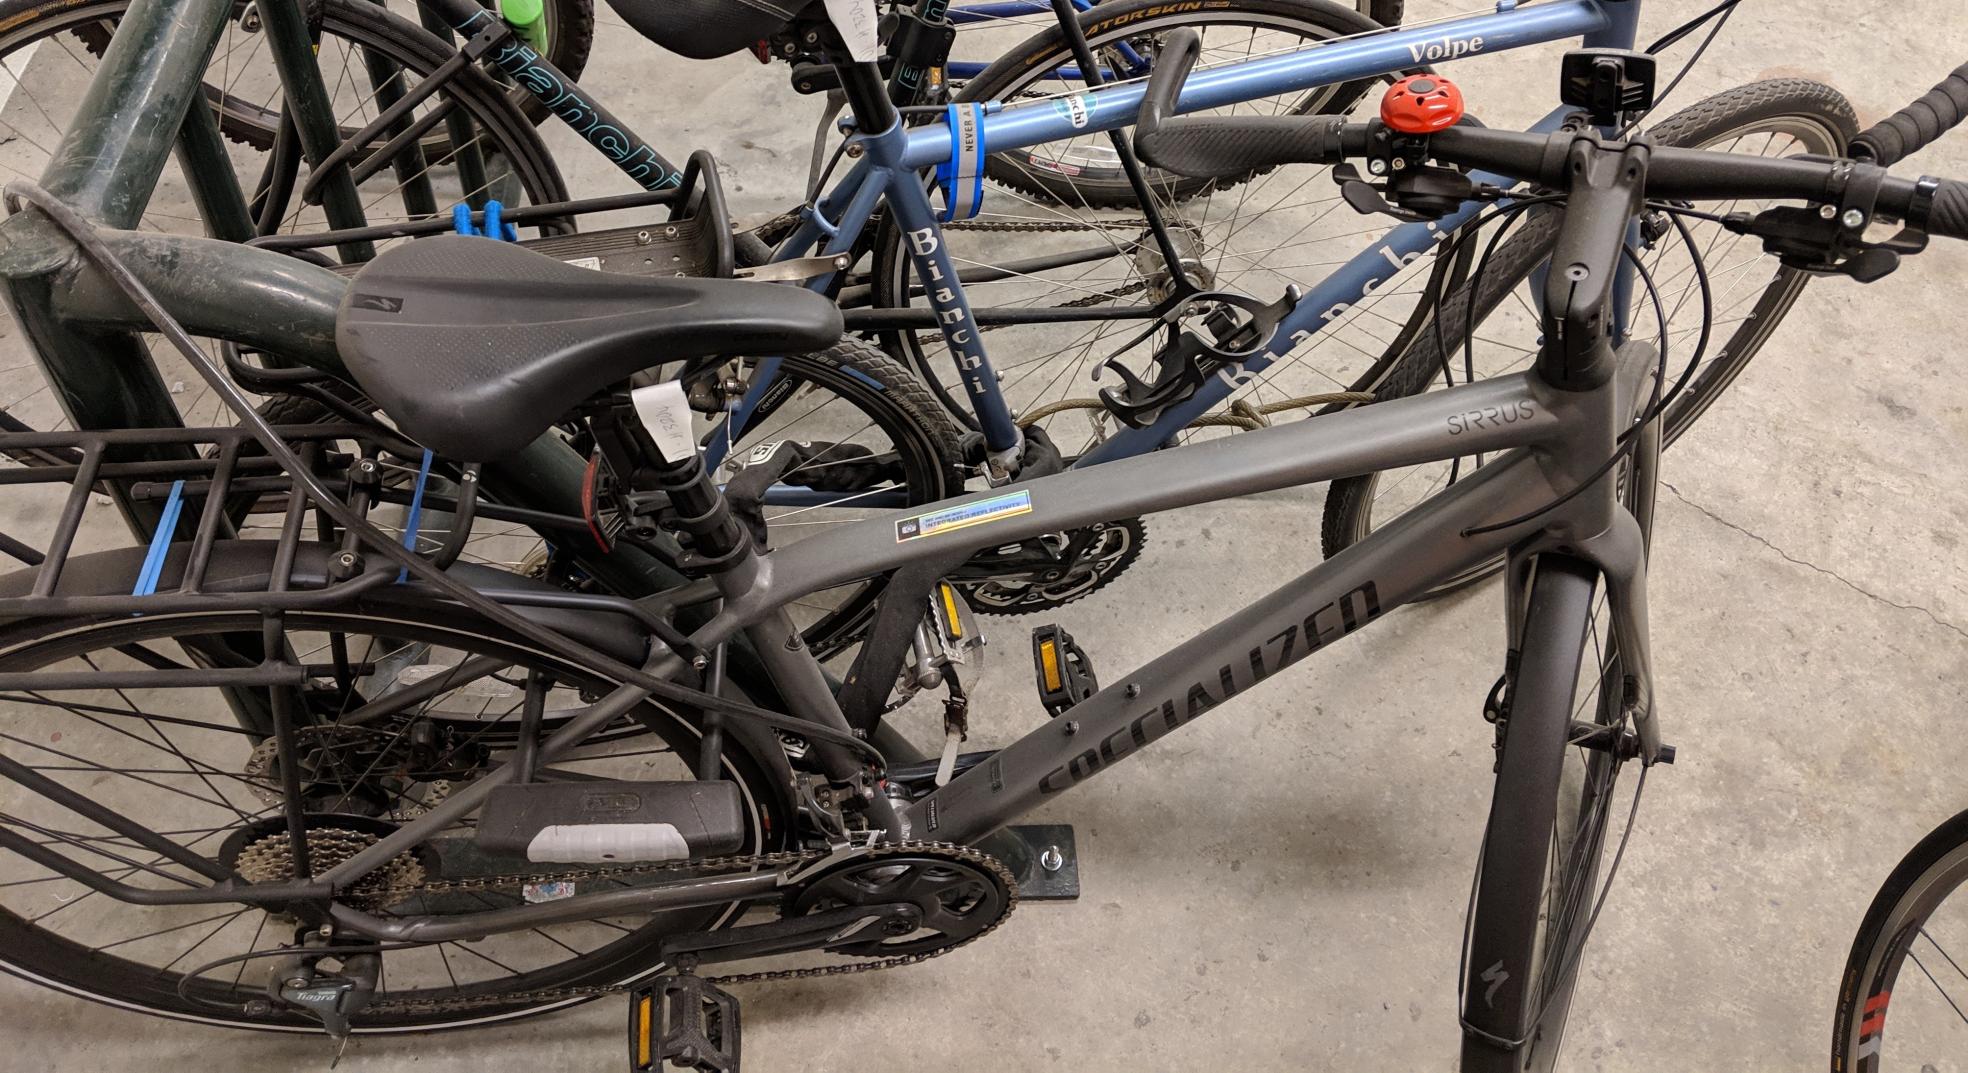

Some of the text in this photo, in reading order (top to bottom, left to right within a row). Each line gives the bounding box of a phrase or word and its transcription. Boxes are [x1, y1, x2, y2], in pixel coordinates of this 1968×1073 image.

[1085, 2, 1200, 36] ATORSKIN
[1408, 36, 1484, 62] Volpe
[1068, 96, 1086, 127] nchi
[964, 120, 975, 152] NEVER
[906, 227, 987, 394] Bianchi
[296, 991, 337, 1002] Tiagra
